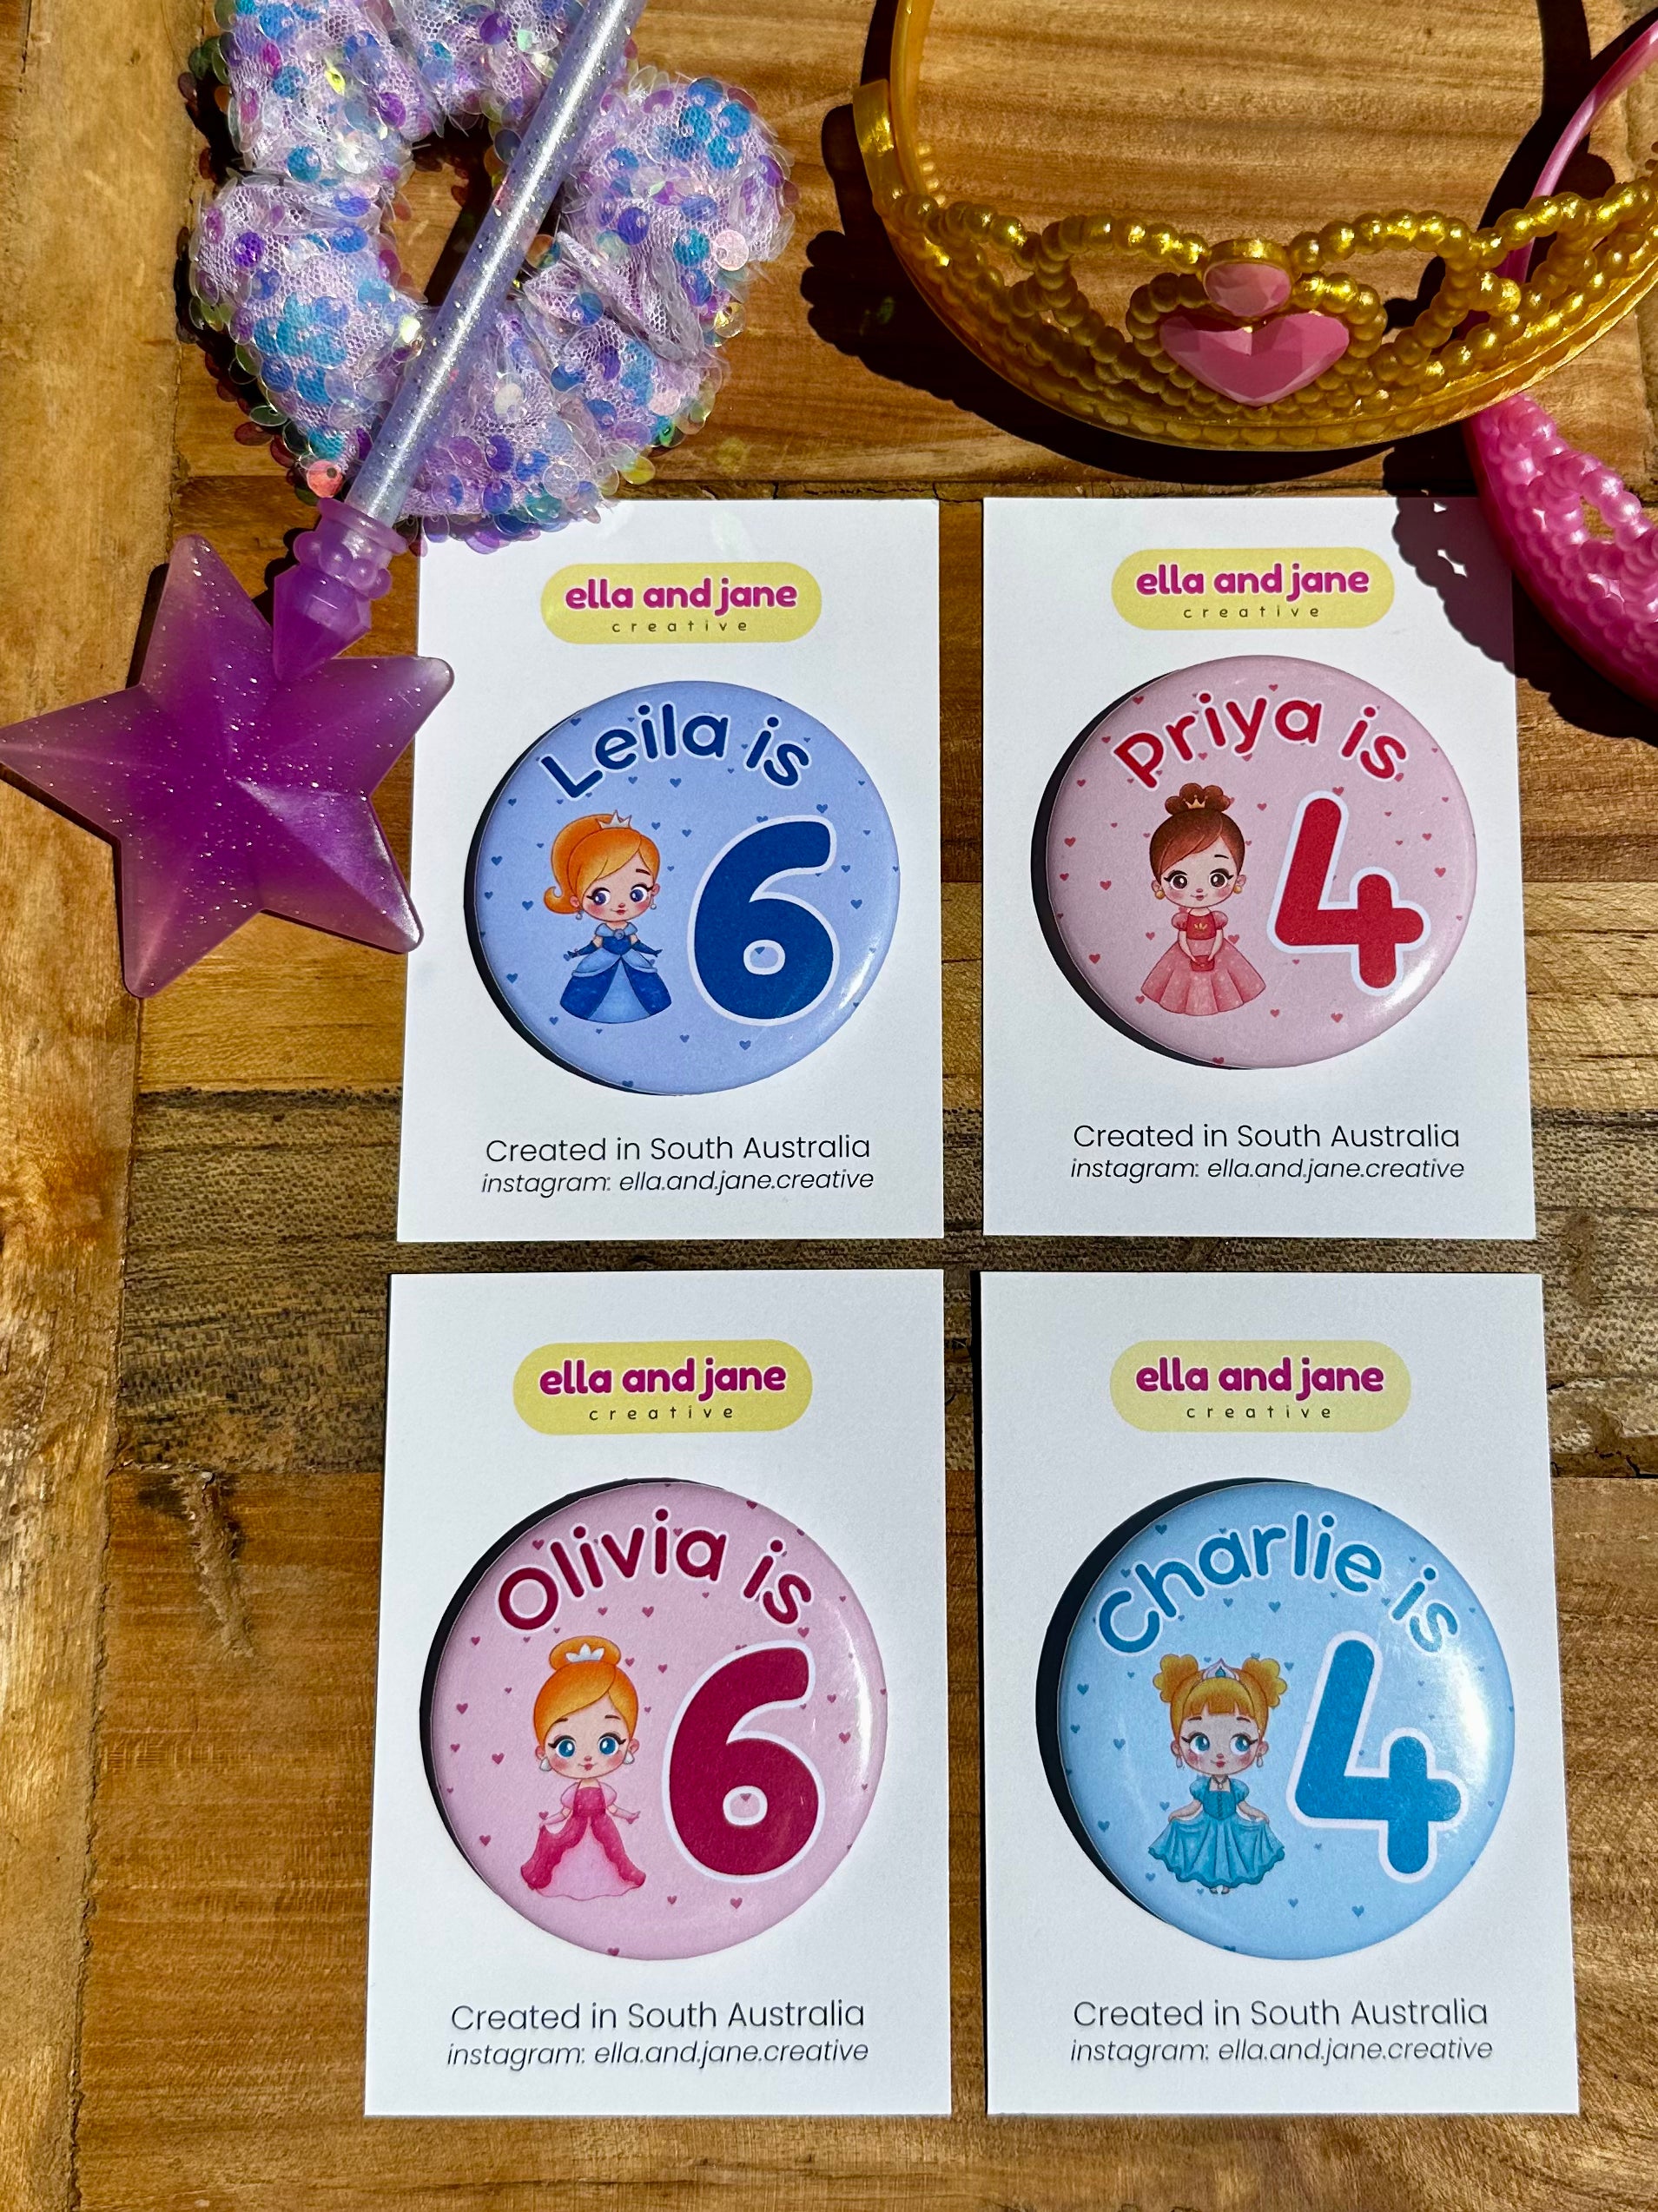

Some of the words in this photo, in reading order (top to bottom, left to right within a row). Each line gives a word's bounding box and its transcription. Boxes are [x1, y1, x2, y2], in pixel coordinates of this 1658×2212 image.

[565, 578, 633, 610] ella
[643, 578, 711, 609] and
[714, 577, 797, 616] jane
[1136, 565, 1205, 596] ella
[1213, 563, 1283, 595] and
[1285, 562, 1370, 602] jane
[611, 619, 748, 634] creative
[1183, 605, 1319, 619] creative
[541, 703, 728, 800] Leila
[746, 716, 809, 787] is
[1113, 692, 1323, 789] Priya
[1341, 705, 1407, 781] is
[1272, 796, 1425, 990] 4
[692, 819, 836, 1020] 6
[486, 1138, 606, 1162] Created
[617, 1138, 640, 1161] in
[651, 1136, 733, 1160] South
[743, 1134, 870, 1159] Australia
[1073, 1124, 1193, 1148] Created
[1204, 1124, 1227, 1147] in
[1238, 1124, 1320, 1147] South
[1331, 1123, 1459, 1147] Australia
[481, 1172, 611, 1198] instagram:
[618, 1169, 874, 1196] ella.and.jane.creative
[1070, 1158, 1199, 1184] instagram:
[1207, 1158, 1464, 1184] ella.and.jane.creative
[538, 1359, 611, 1396] ella
[621, 1357, 696, 1395] and
[697, 1357, 787, 1402] jane
[1135, 1357, 1208, 1393] ella
[1219, 1357, 1291, 1392] and
[1295, 1357, 1384, 1402] jane
[589, 1404, 734, 1421] creative
[1186, 1404, 1331, 1419] creative
[498, 1508, 728, 1631] Olivia
[743, 1539, 812, 1626] is
[1098, 1514, 1383, 1654] Charlie
[1391, 1566, 1458, 1651] is
[668, 1646, 821, 1877] 6
[1293, 1638, 1463, 1875] 4
[451, 2003, 580, 2030] Created
[591, 2003, 617, 2029] in
[628, 2001, 717, 2029] South
[728, 1999, 864, 2028] Australia
[1073, 1999, 1203, 2027] Created
[1214, 1999, 1240, 2026] in
[1251, 1998, 1340, 2026] South
[1351, 1997, 1488, 2025] Australia
[447, 2043, 585, 2071] instagram:
[595, 2038, 869, 2070] ella.and.jane.creative
[1070, 2039, 1210, 2068] instagram:
[1218, 2037, 1493, 2067] ella.and.jane.creative
